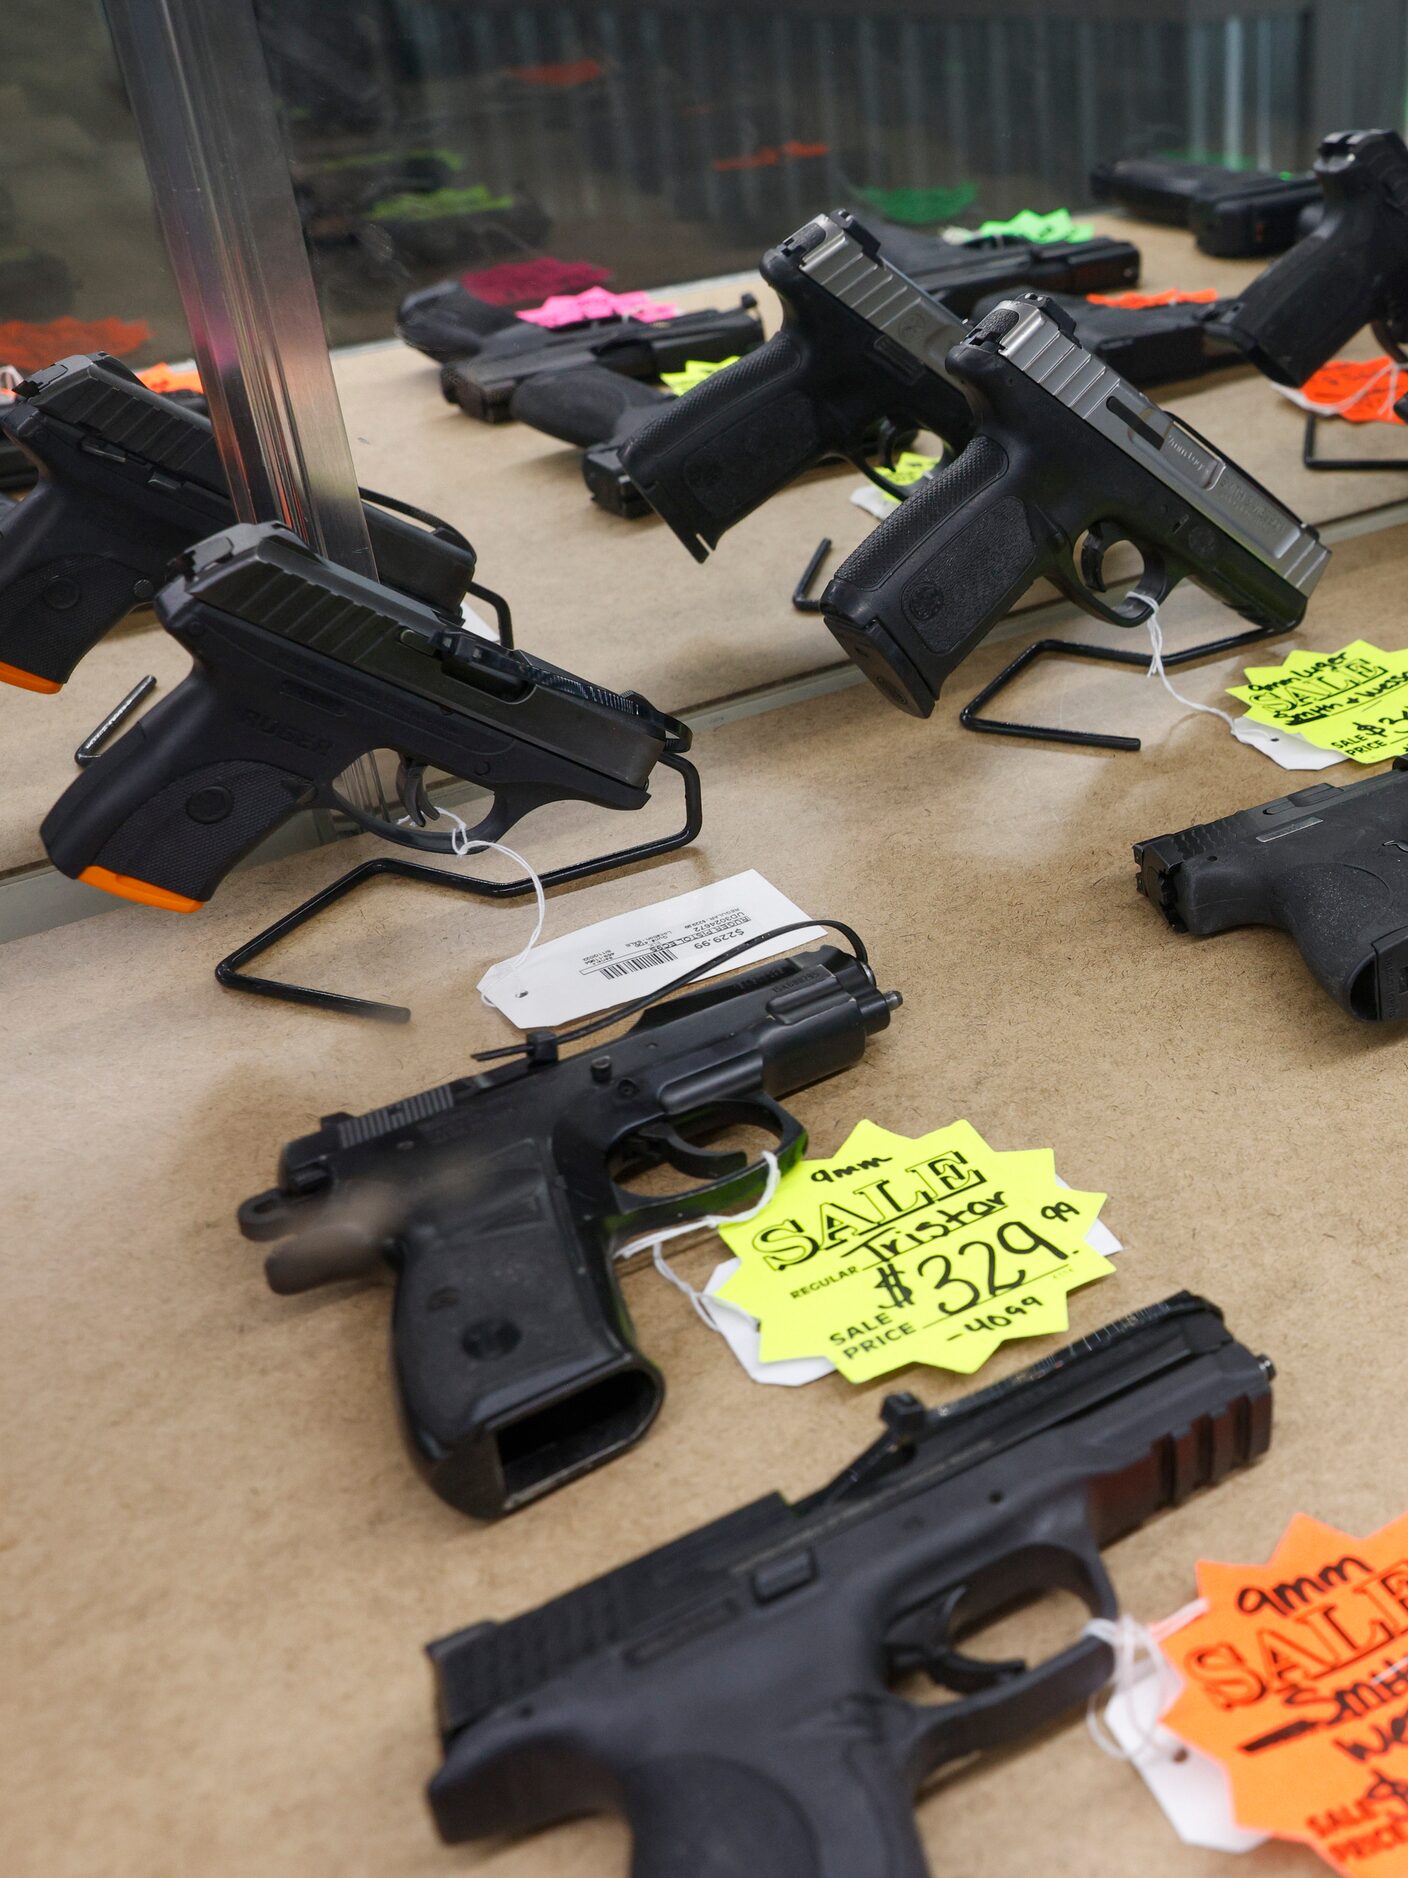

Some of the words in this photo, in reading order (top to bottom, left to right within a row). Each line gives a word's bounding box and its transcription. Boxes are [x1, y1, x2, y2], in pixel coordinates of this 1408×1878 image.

[1249, 658, 1389, 713] SALE
[1273, 700, 1344, 726] Smith
[1331, 734, 1368, 749] SALE
[1345, 739, 1388, 757] PRICE
[677, 926, 713, 945] PISTOL
[694, 927, 745, 950] $229.99
[715, 915, 751, 934] RUGER
[810, 1154, 894, 1184] 9mm
[752, 1150, 989, 1273] SALE
[789, 1264, 860, 1301] REGULAR
[828, 1311, 894, 1348] SALE
[842, 1321, 918, 1361] PRICE
[1233, 1553, 1378, 1620] 9mm
[1304, 1797, 1380, 1839] SALE
